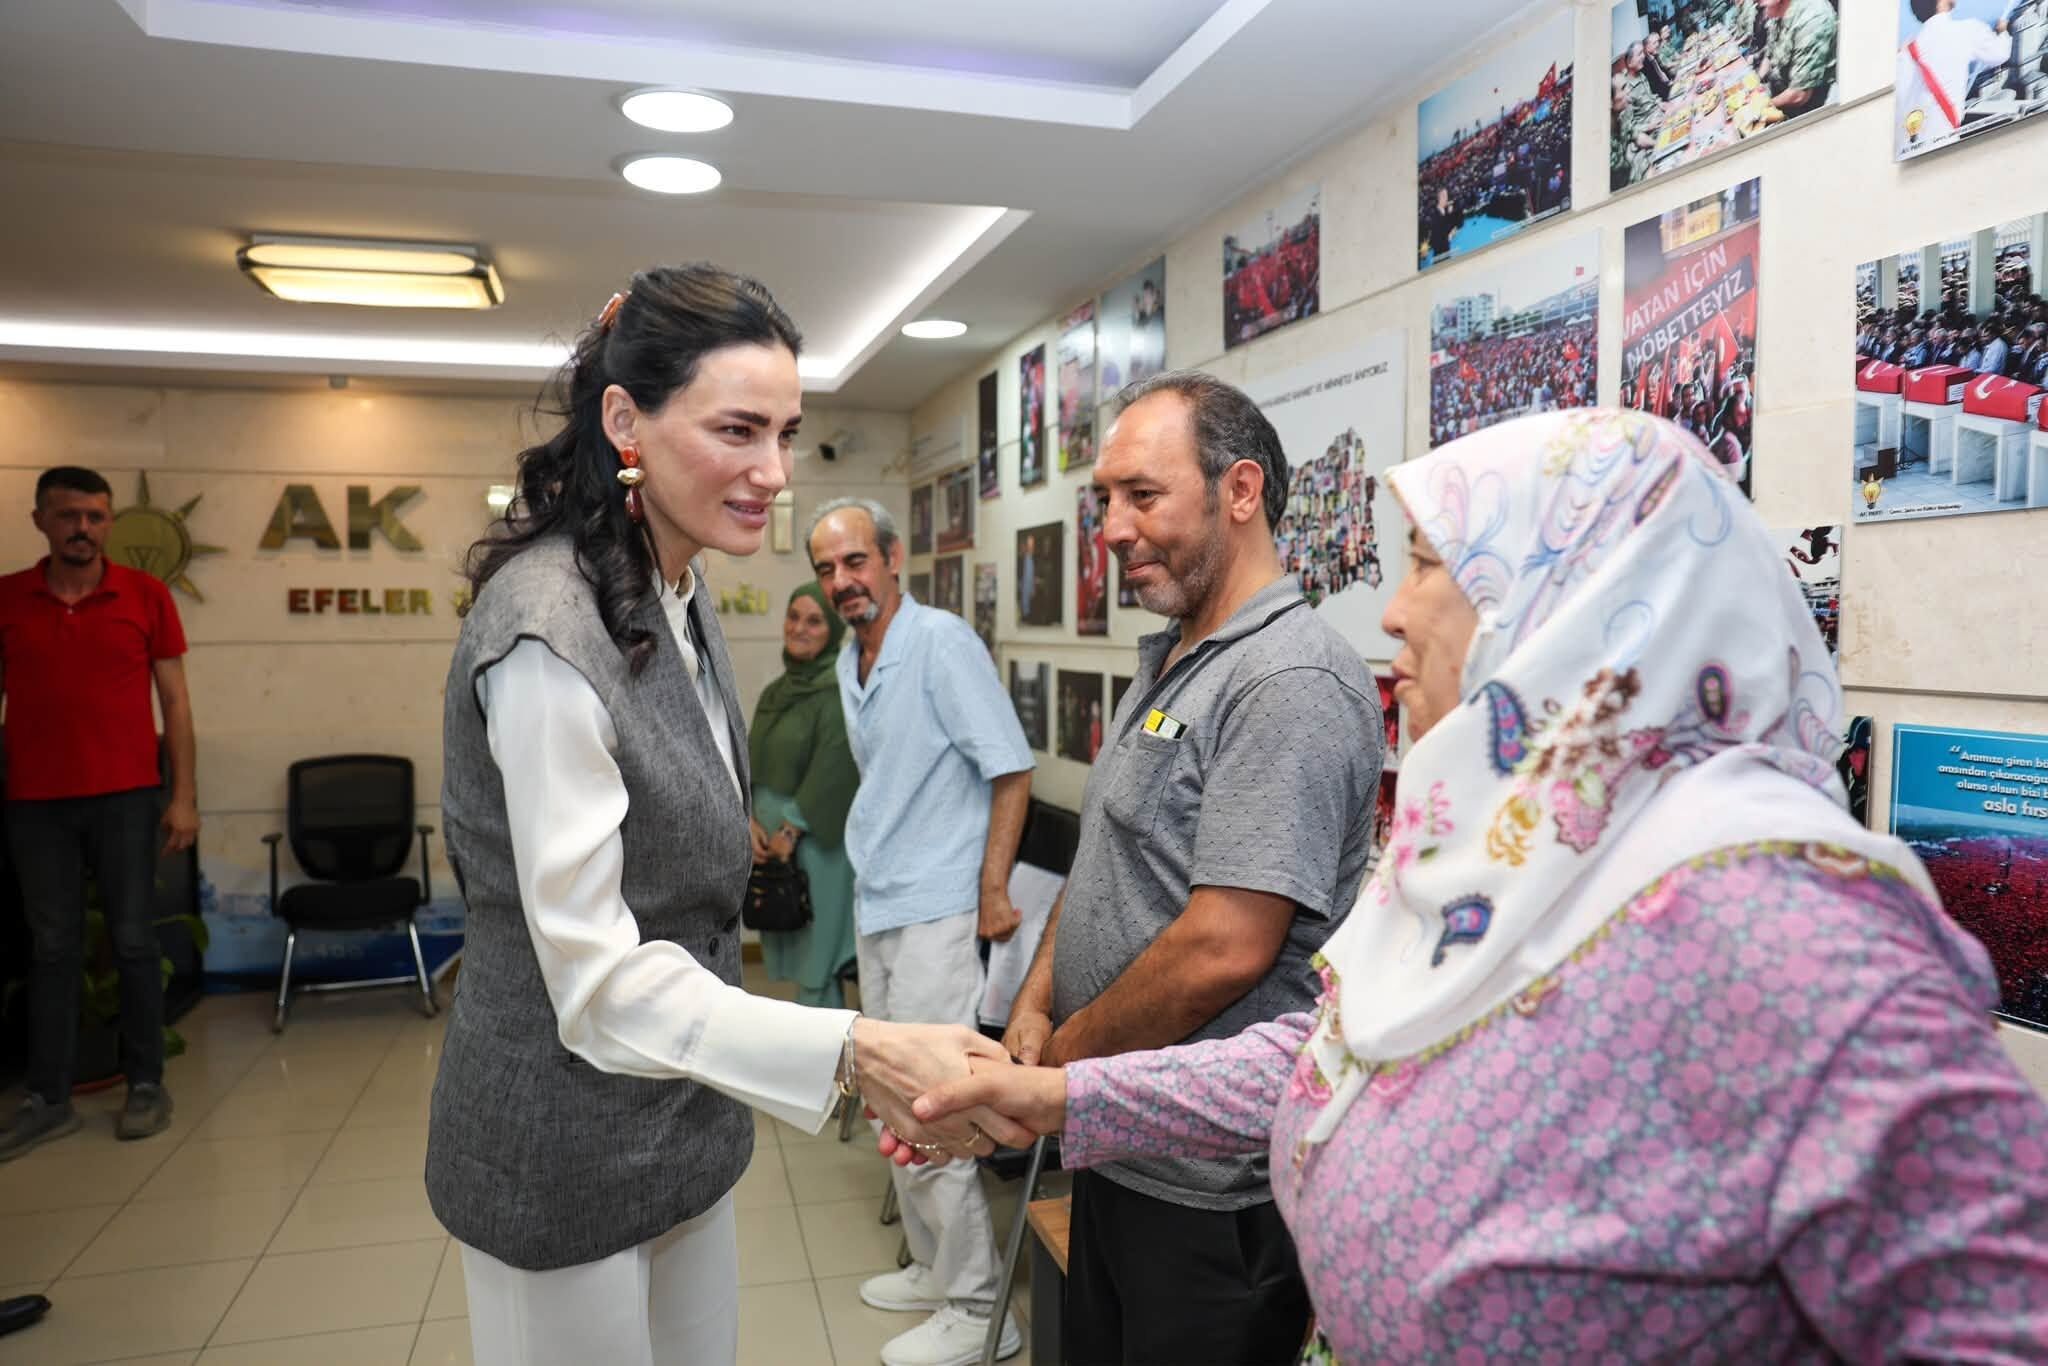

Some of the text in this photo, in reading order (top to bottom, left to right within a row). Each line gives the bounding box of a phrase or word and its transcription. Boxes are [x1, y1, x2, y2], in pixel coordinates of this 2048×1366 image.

[1682, 243, 1728, 295] İÇİN
[1626, 269, 1746, 372] NÖBETTEYİZ
[258, 484, 423, 550] AK
[288, 588, 433, 615] EFELER
[1983, 798, 2017, 814] asla
